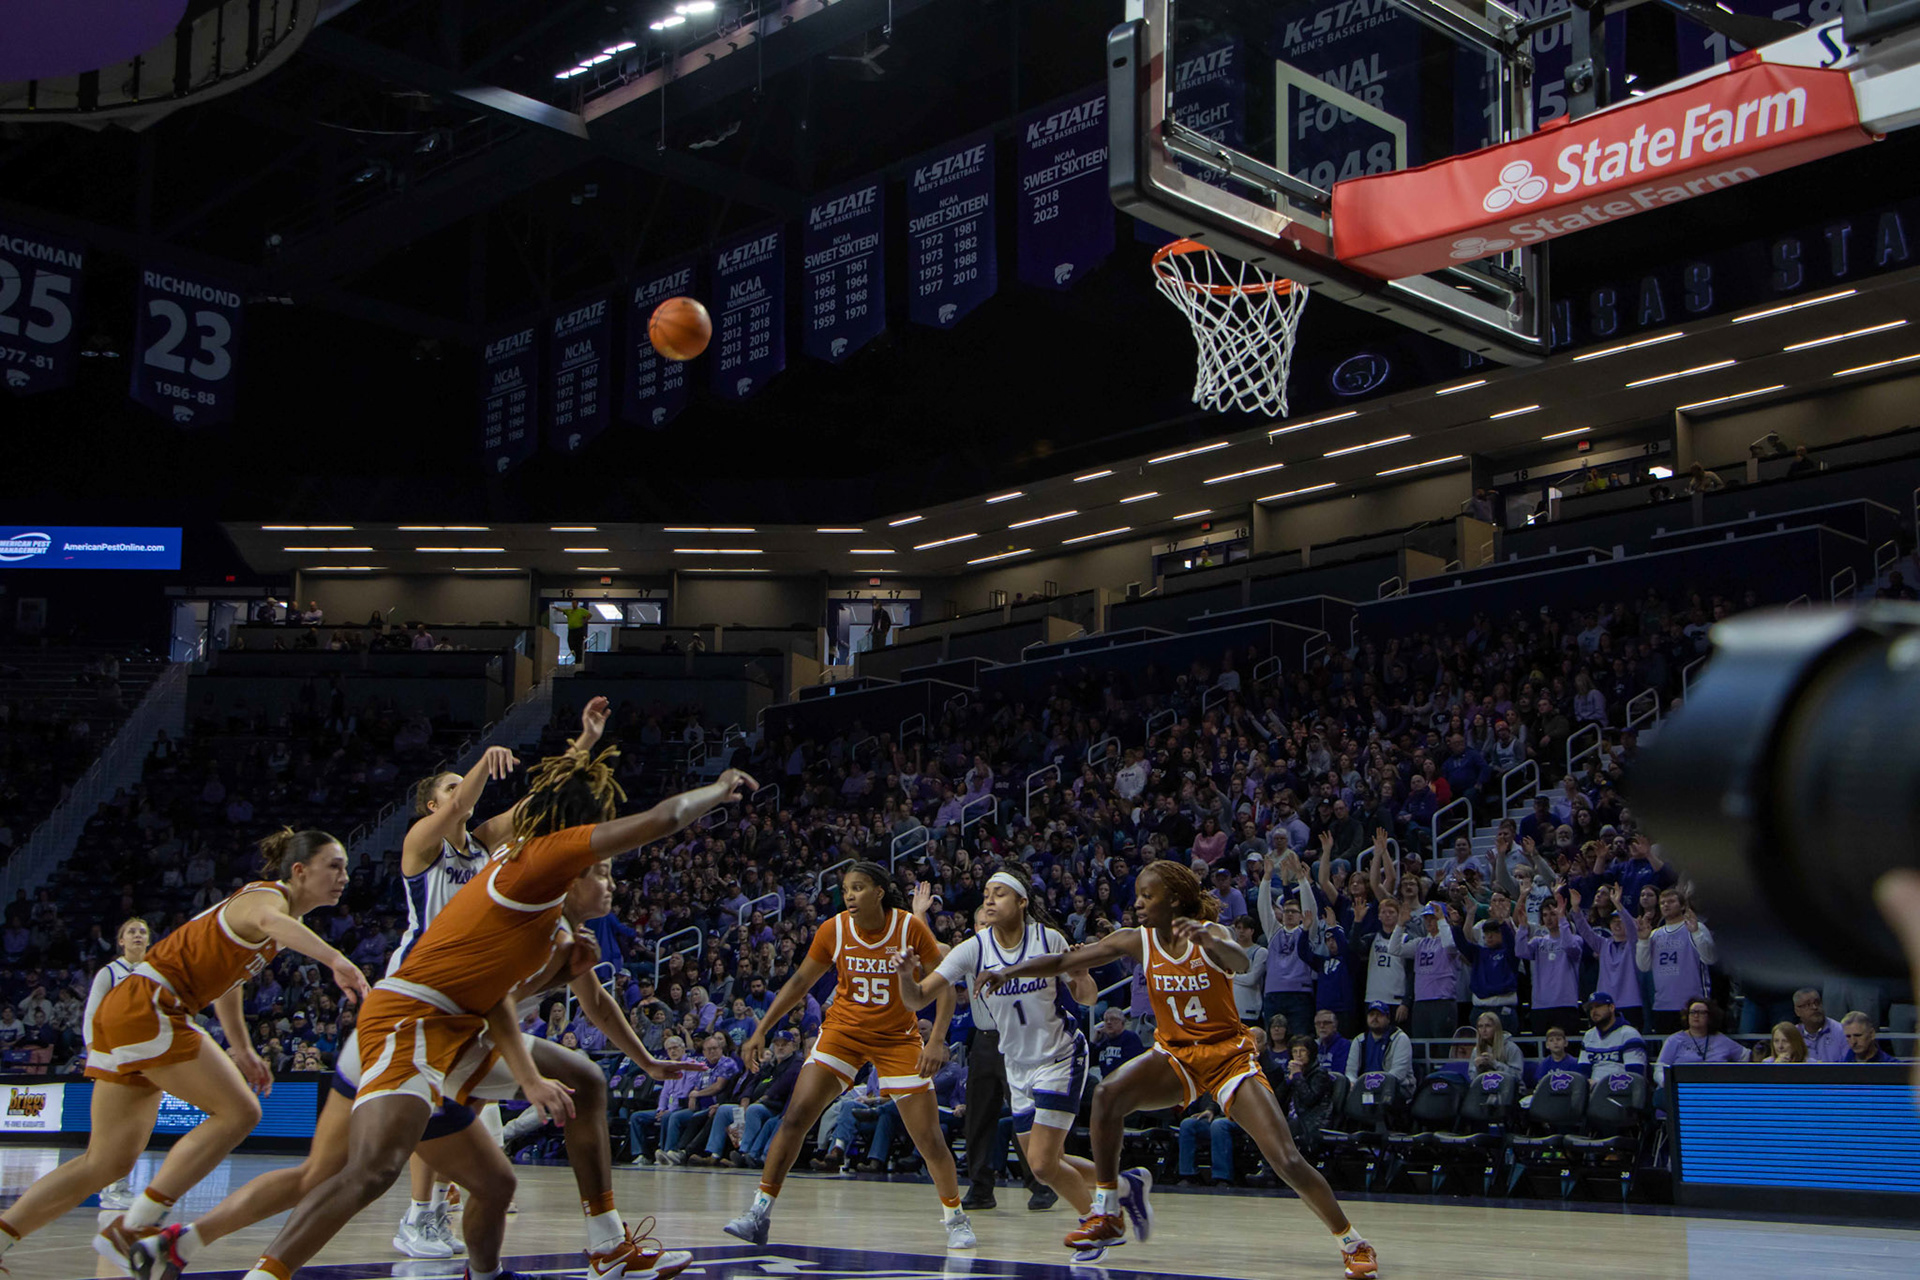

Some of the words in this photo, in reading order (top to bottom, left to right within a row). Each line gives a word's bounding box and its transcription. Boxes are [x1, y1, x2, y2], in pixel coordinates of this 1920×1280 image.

[1290, 35, 1325, 58] MEN'S
[1326, 8, 1399, 44] BASKETBALL
[1026, 95, 1107, 144] K-STATE
[1186, 102, 1231, 130] EIGHT
[1031, 135, 1054, 151] MEN'S
[1054, 116, 1100, 143] BASKETBALL
[913, 143, 987, 188] K-STATE
[1023, 164, 1061, 192] SWEET
[1061, 146, 1108, 177] SIXTEEN
[1054, 148, 1077, 165] NCAA
[918, 178, 940, 194] MEN'S
[940, 164, 981, 189] BASKETBALL
[809, 185, 878, 227] K-STATE
[939, 195, 959, 209] NCAA
[1034, 189, 1060, 209] 2018
[909, 211, 943, 234] SWEET
[942, 192, 989, 219] SIXTEEN
[1033, 205, 1060, 225] 2023
[832, 233, 852, 248] NCAA
[921, 233, 944, 250] 1972
[954, 220, 977, 238] 1981
[717, 233, 778, 271] K-STATE
[803, 247, 838, 270] SWEET
[838, 232, 879, 258] SIXTEEN
[920, 248, 943, 266] 1973
[953, 236, 978, 254] 1982
[814, 270, 836, 286] 1951
[846, 259, 868, 276] 1961
[919, 264, 943, 281] 1975
[953, 252, 978, 270] 1988
[144, 270, 241, 309] RICHMOND
[634, 267, 691, 304] K-STATE
[730, 275, 763, 300] NCAA
[814, 285, 837, 301] 1956
[845, 274, 868, 291] 1964
[918, 279, 943, 297] 1977
[952, 268, 978, 286] 2010
[721, 313, 742, 329] 2011
[750, 301, 771, 318] 2017
[814, 300, 836, 316] 1958
[845, 289, 868, 305] 1968
[554, 299, 606, 334] K-STATE
[721, 327, 743, 343] 2012
[749, 316, 771, 333] 2018
[813, 314, 836, 331] 1959
[845, 304, 868, 321] 1970
[144, 299, 232, 381] 23
[484, 328, 535, 361] K-STATE
[564, 337, 593, 360] NCAA
[720, 341, 743, 357] 2013
[749, 330, 771, 348] 2019
[662, 361, 684, 378] 2008
[720, 355, 742, 372] 2014
[749, 346, 770, 362] 2023
[494, 366, 521, 387] NCAA
[662, 376, 684, 393] 2010
[154, 381, 216, 406] 1986-88
[1643, 443, 1659, 454] 19
[1514, 470, 1528, 481] 18
[63, 543, 165, 552] AmericanPestOnline.com
[1167, 542, 1178, 552] 17
[1235, 528, 1247, 538] 18
[560, 590, 574, 598] 16
[638, 590, 651, 598] 17
[847, 591, 860, 599] 17
[888, 591, 901, 599] 17
[845, 956, 898, 974] TEXAS
[1377, 956, 1391, 967] 21
[1420, 952, 1434, 966] 22
[1659, 951, 1678, 965] 24
[852, 977, 890, 1005] 35
[987, 977, 1048, 996] ildcats
[1152, 972, 1211, 992] TEXAS
[1013, 1000, 1027, 1026] 1
[1166, 995, 1208, 1026] 14
[1587, 1051, 1620, 1061] CATS
[9, 1087, 46, 1117] Briggs
